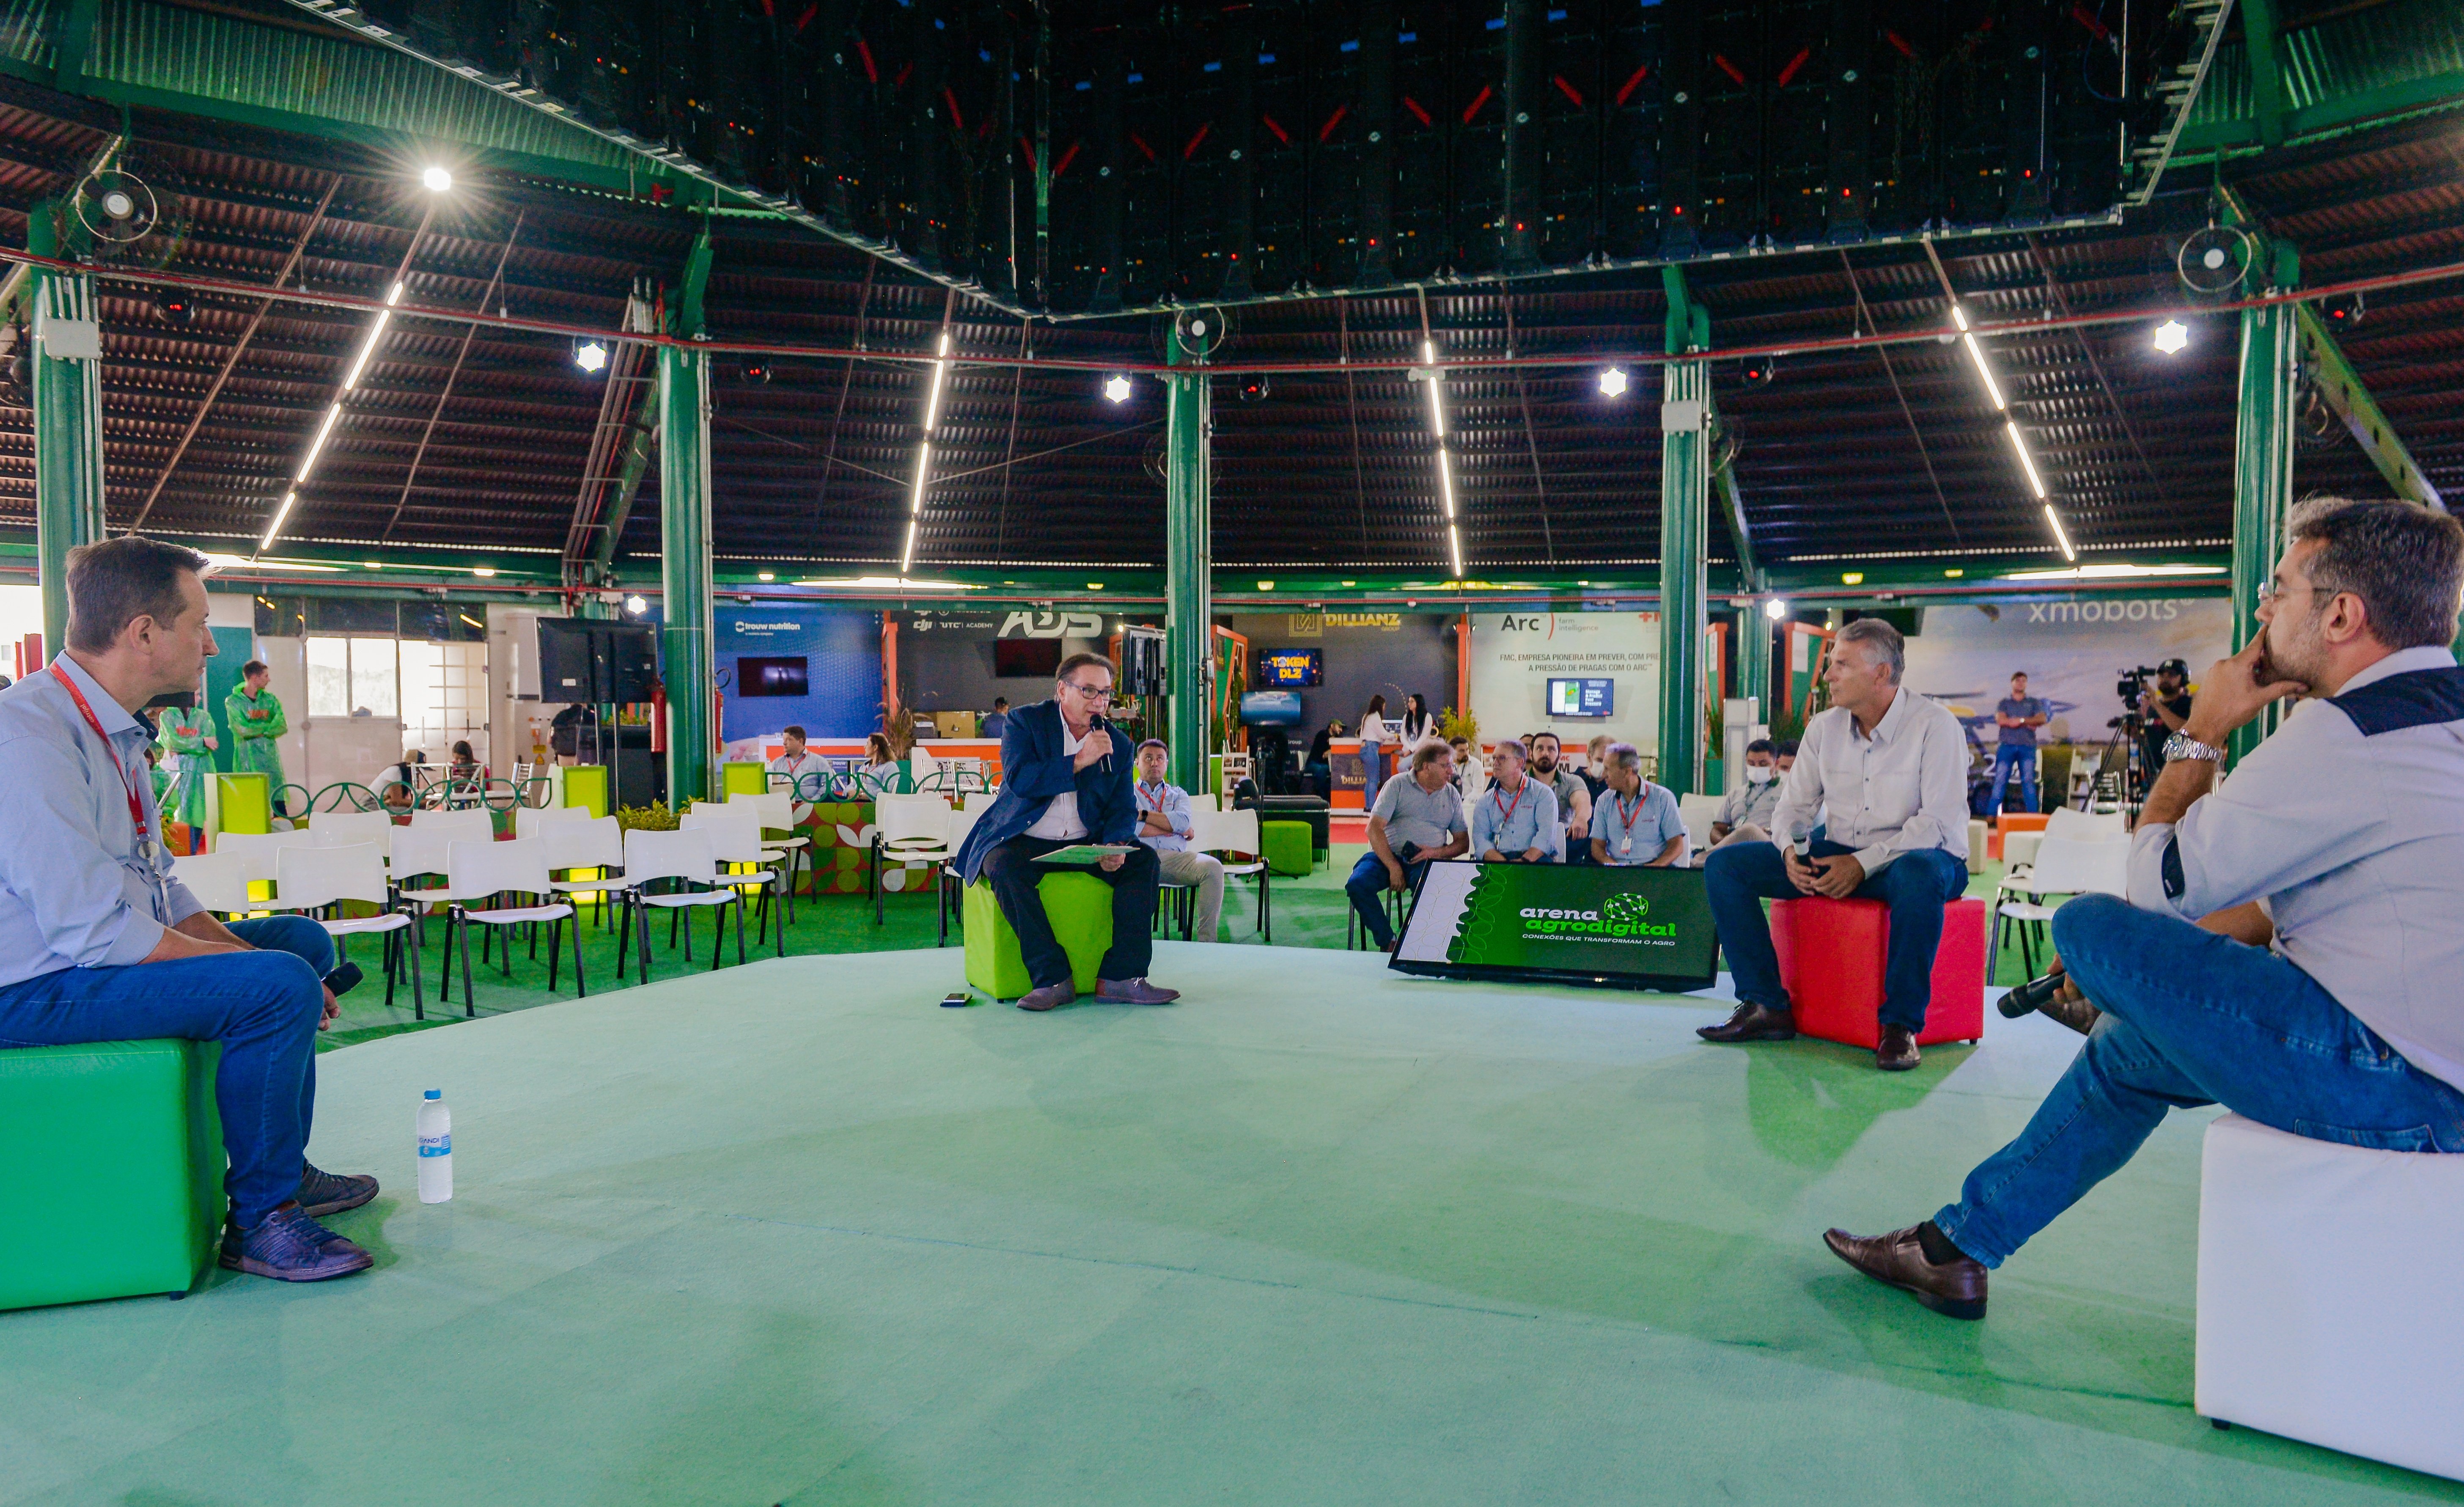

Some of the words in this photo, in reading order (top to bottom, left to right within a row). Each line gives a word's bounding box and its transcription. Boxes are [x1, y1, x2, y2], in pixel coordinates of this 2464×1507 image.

[2030, 599, 2177, 622] xmobots
[1326, 613, 1399, 626] DILLIANZ
[1501, 615, 1539, 631] Arc
[1559, 624, 1599, 632] intelligence
[1271, 656, 1309, 668] TOKEN
[1536, 663, 1566, 671] PRESSÃO
[1279, 668, 1302, 679] DLZ
[1520, 908, 1598, 921] arena
[1526, 920, 1676, 936] agrodigital
